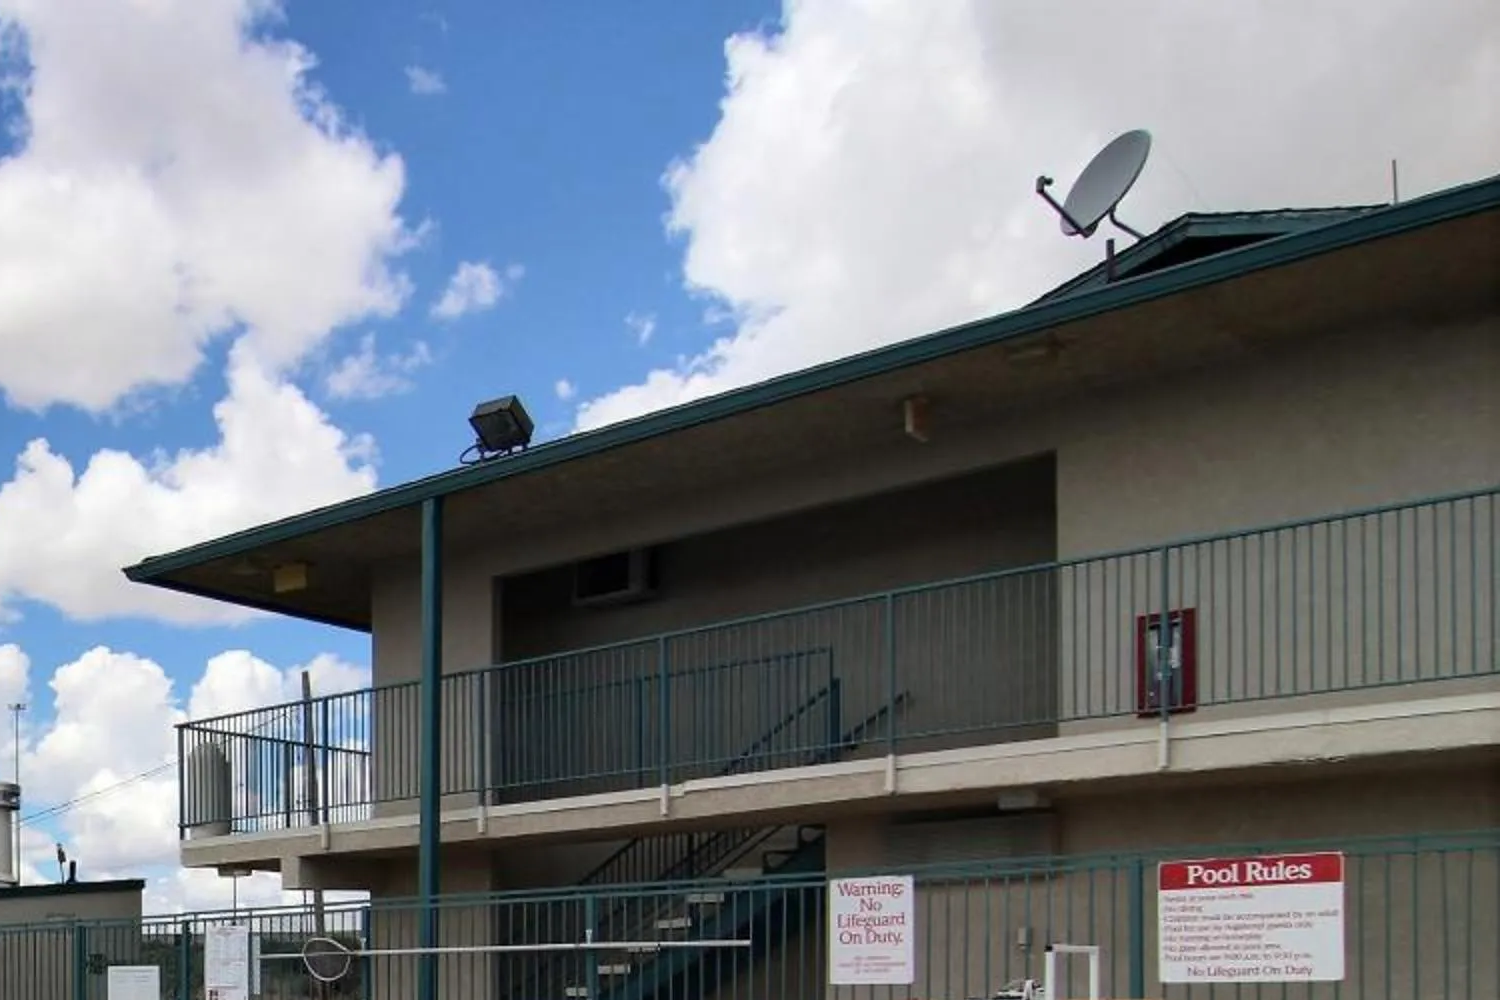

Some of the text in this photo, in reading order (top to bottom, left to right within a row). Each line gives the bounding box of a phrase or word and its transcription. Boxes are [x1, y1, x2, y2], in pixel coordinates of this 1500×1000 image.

[1187, 860, 1312, 885] Pool Rules
[860, 898, 882, 912] No
[837, 912, 905, 931] Lifeguard
[840, 931, 862, 945] On
[1262, 965, 1281, 976] On
